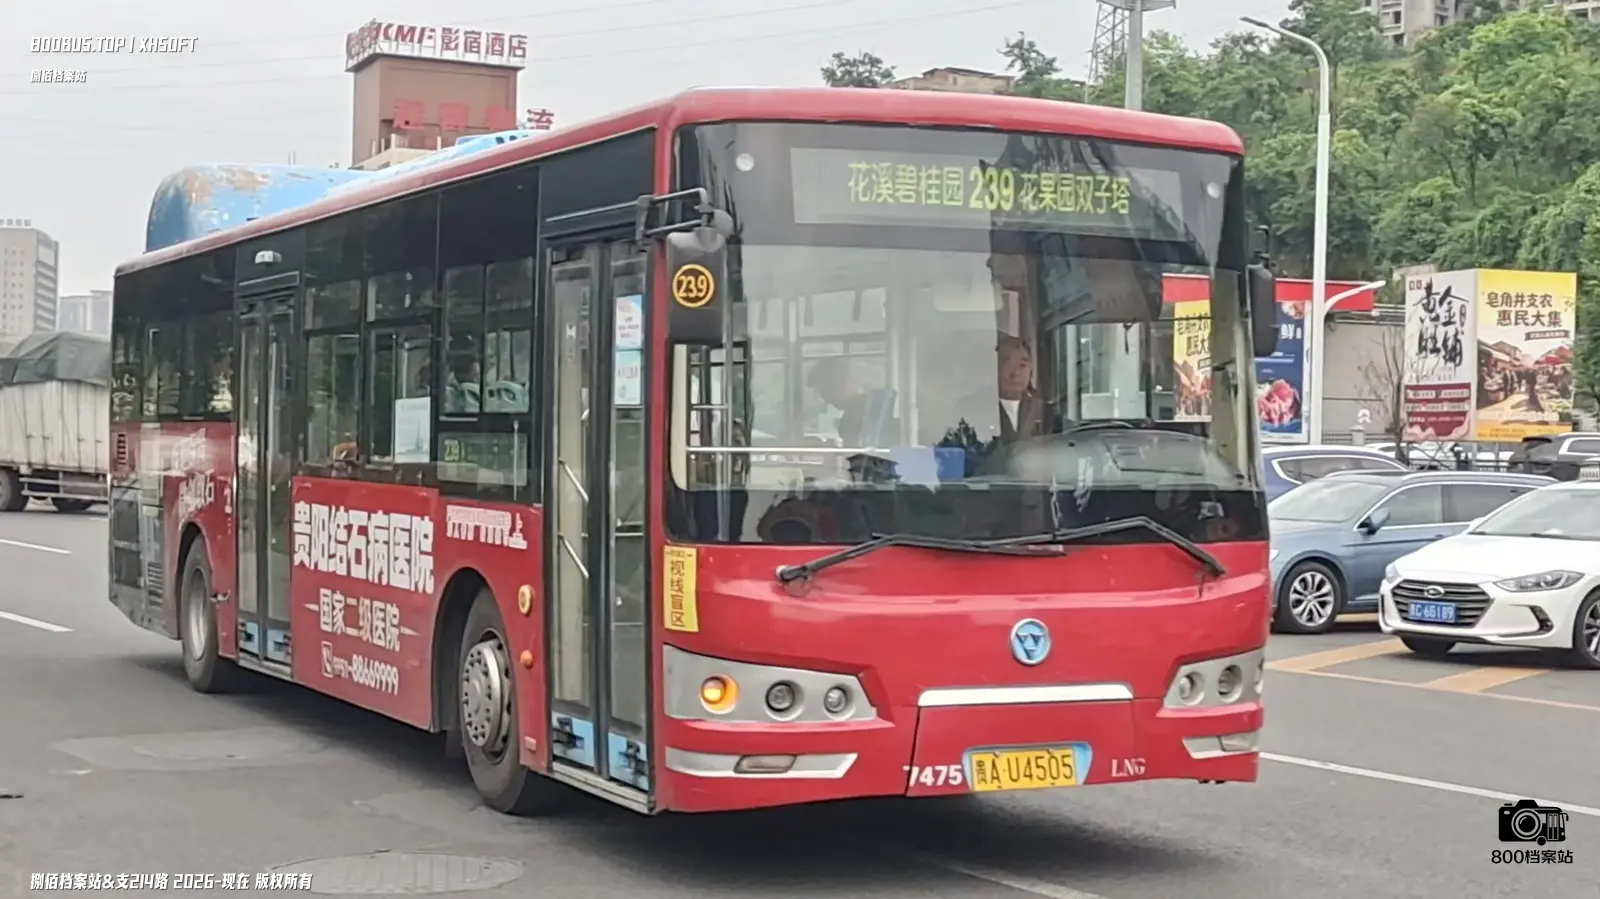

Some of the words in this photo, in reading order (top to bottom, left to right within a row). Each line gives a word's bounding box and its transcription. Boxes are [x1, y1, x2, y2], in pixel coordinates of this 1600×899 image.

[848, 161, 964, 206] 花溪碧桂园
[969, 166, 1015, 211] 239
[1020, 171, 1130, 215] 花果园双子塔
[678, 274, 708, 298] 239
[1486, 291, 1552, 308] 皂角井支农
[1496, 309, 1562, 327] 惠民大集
[293, 500, 435, 594] 贵阳结石病医院
[319, 587, 400, 652] 国家二级医院
[903, 765, 963, 787] 7475
[1111, 757, 1146, 778] LNG
